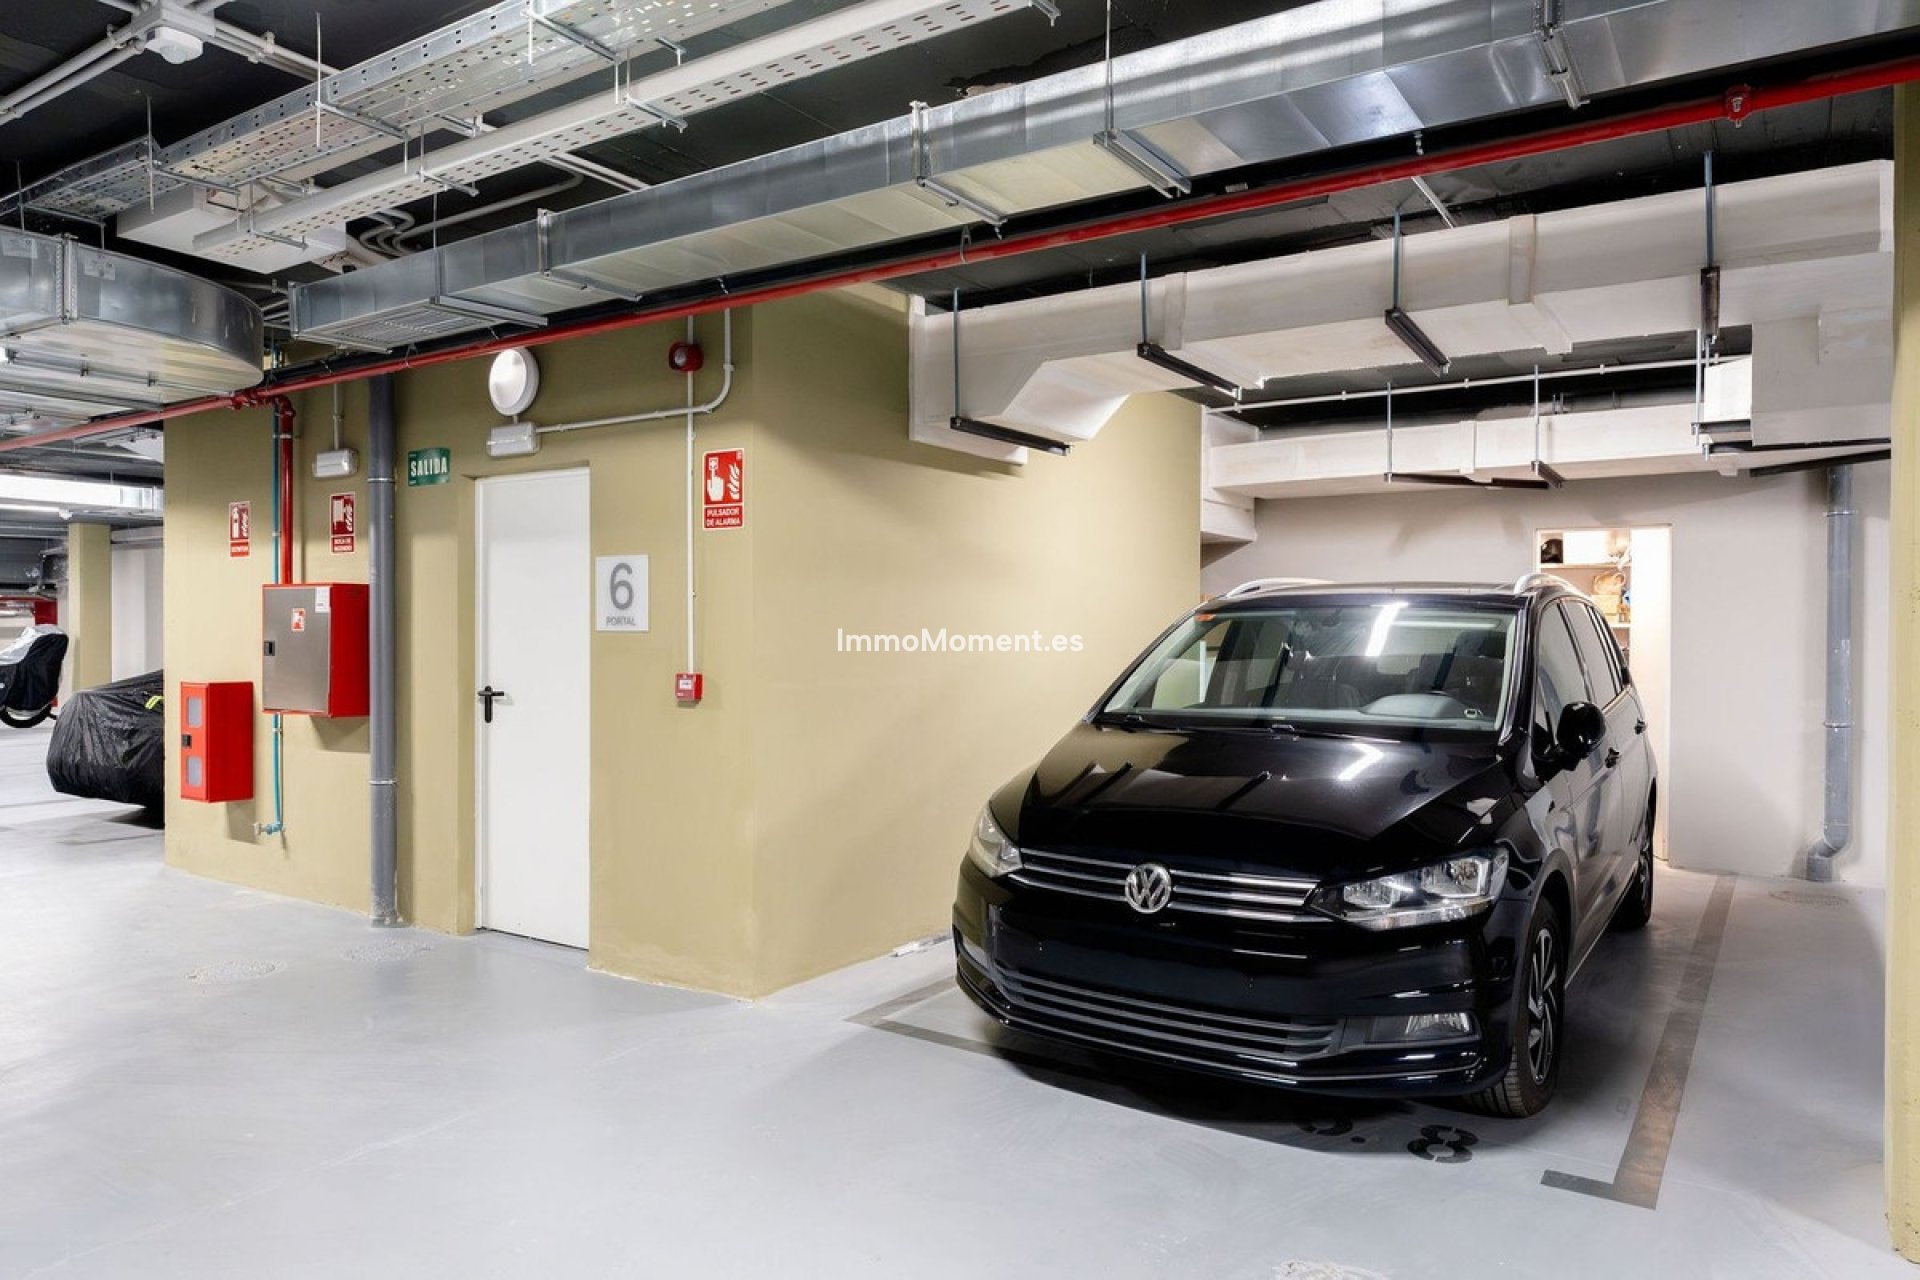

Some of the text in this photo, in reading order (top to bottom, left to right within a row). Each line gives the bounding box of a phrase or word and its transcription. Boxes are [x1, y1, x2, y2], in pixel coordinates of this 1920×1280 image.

[411, 457, 448, 477] SALIDA
[706, 507, 740, 517] PULSADOR
[707, 518, 714, 527] DE
[610, 563, 634, 610] 6
[606, 616, 636, 627] PORTAL
